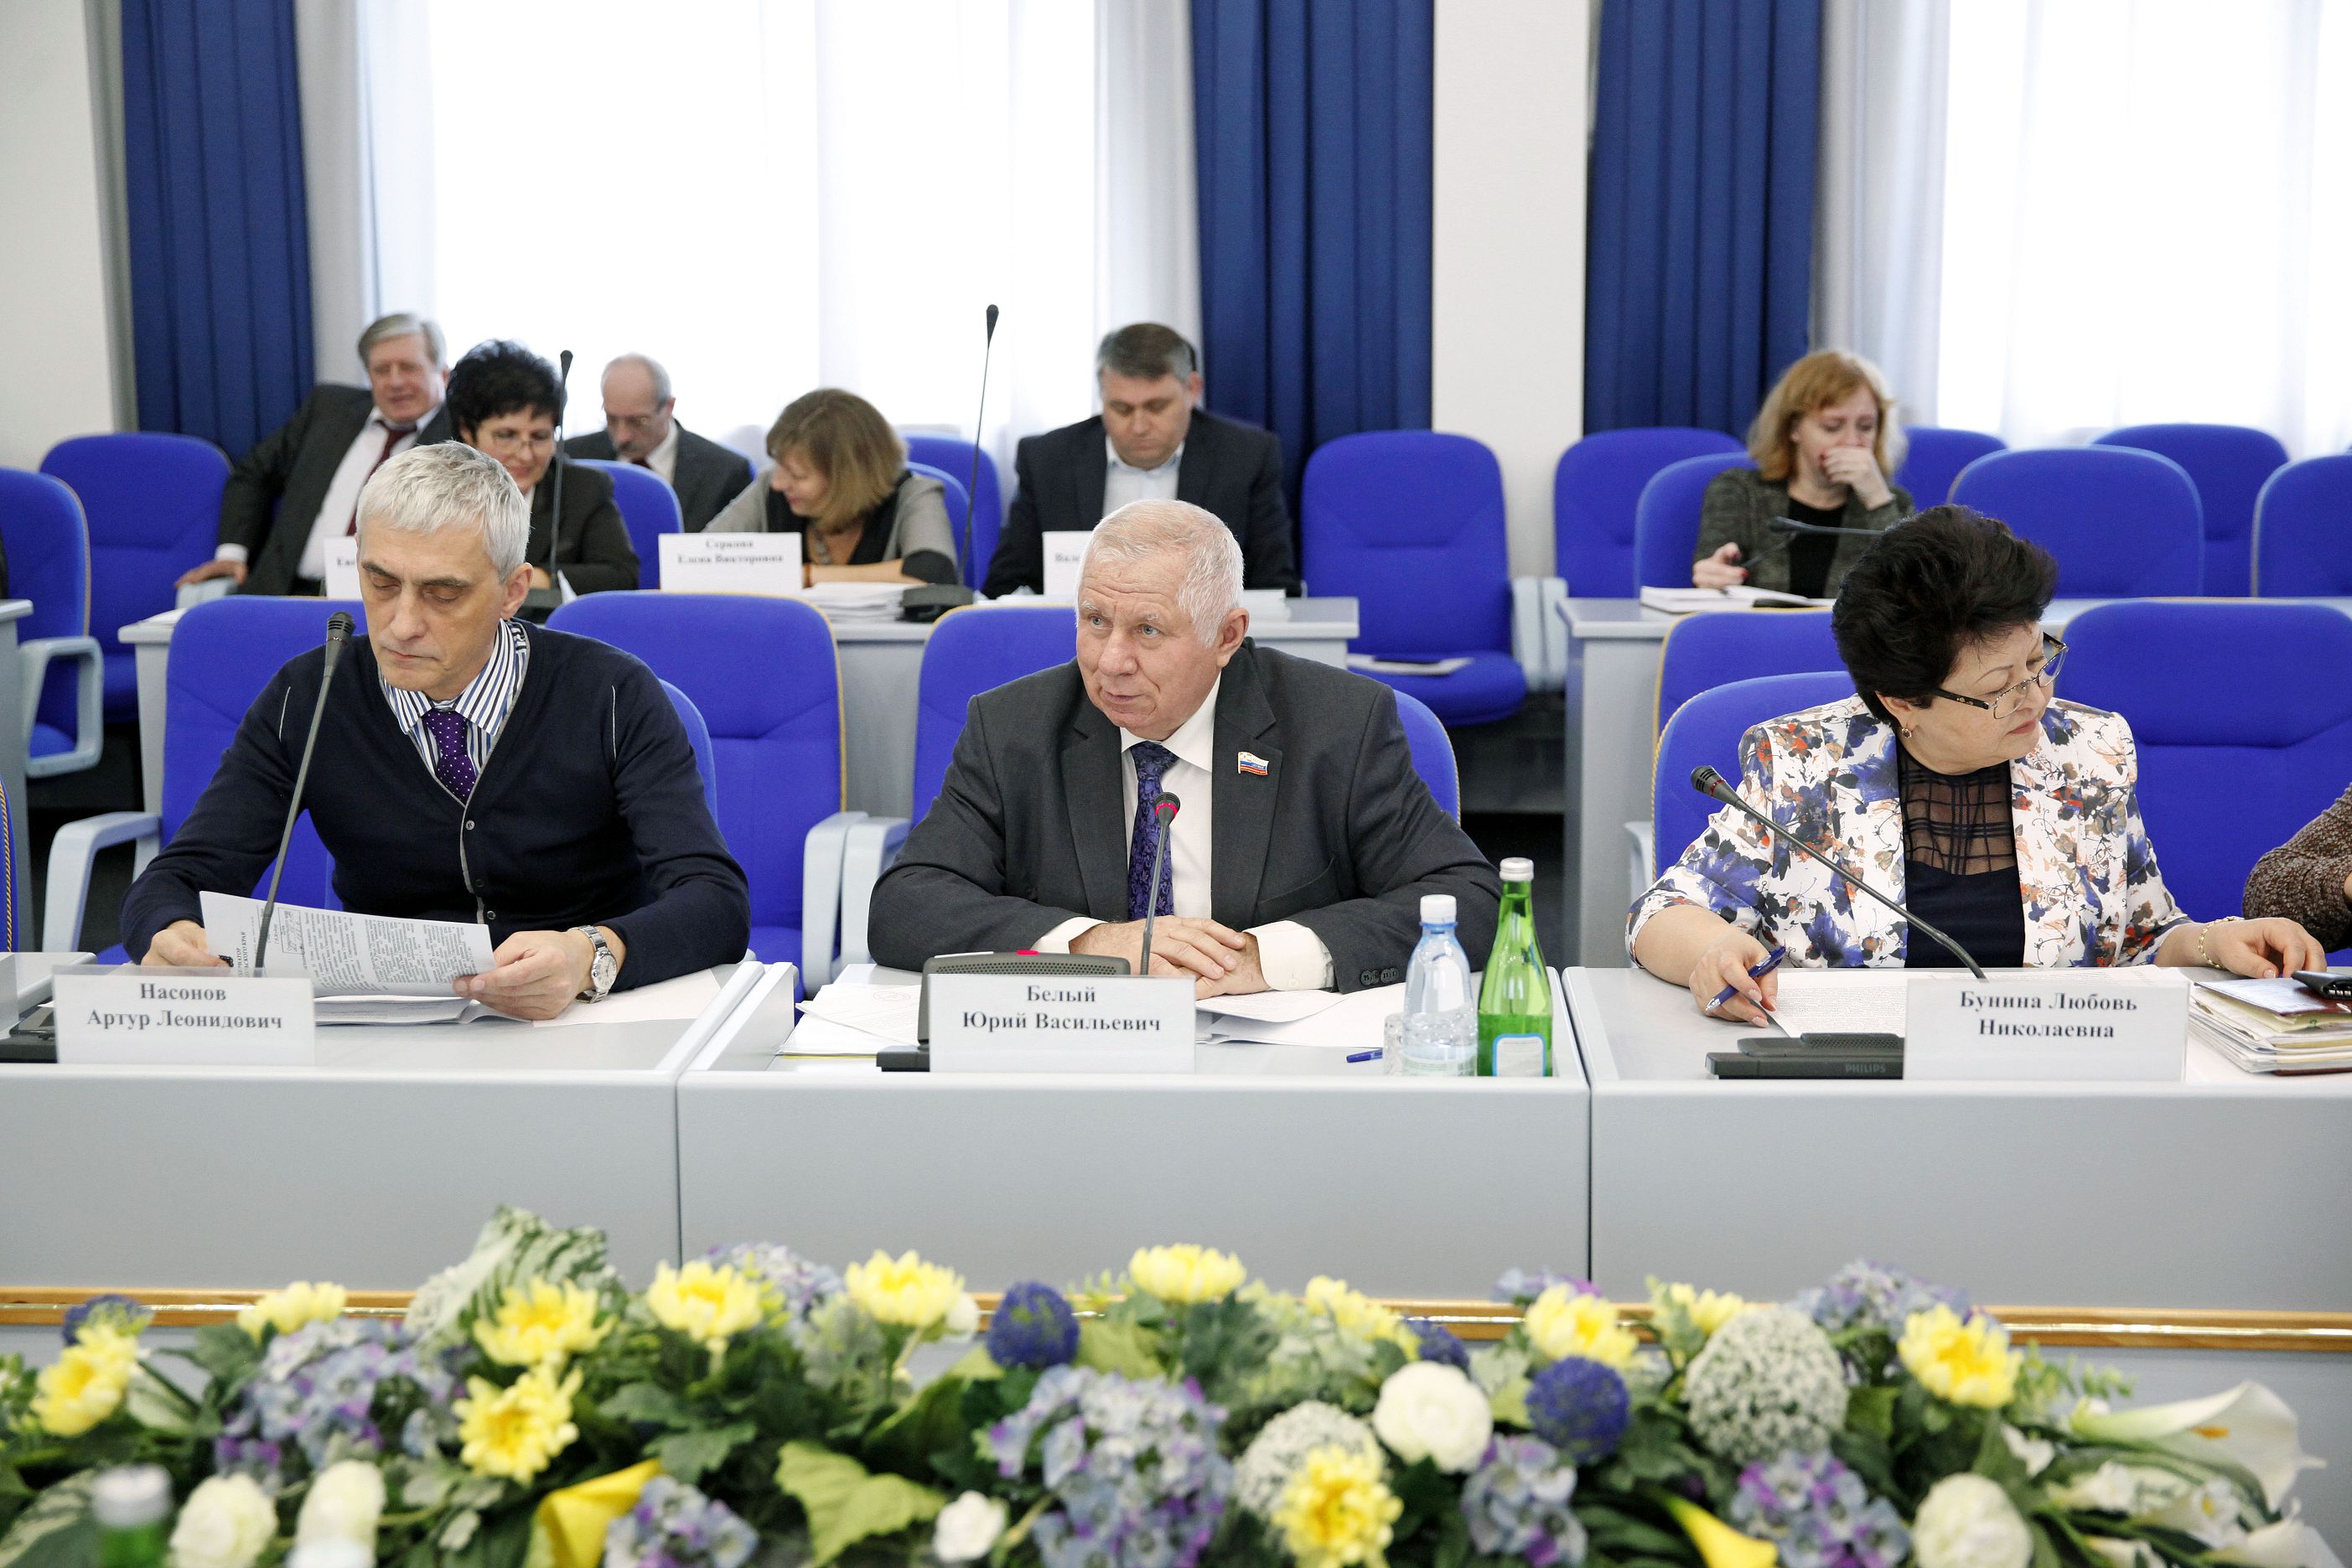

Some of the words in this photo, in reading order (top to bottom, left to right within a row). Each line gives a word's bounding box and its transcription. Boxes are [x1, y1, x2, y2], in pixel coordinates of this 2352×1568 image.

[677, 554, 712, 565] Елена
[140, 983, 226, 1001] Насонов
[1027, 985, 1096, 1002] Белый
[1961, 991, 2041, 1012] Бунина
[2049, 992, 2137, 1011] Любовь
[87, 1009, 151, 1031] Артур
[157, 1010, 282, 1029] Леонидович
[963, 1012, 1027, 1032] Юрий
[1036, 1012, 1160, 1031] Васильевич
[1979, 1018, 2114, 1038] Николаевна
[1845, 1063, 1886, 1074] PHILIPS
